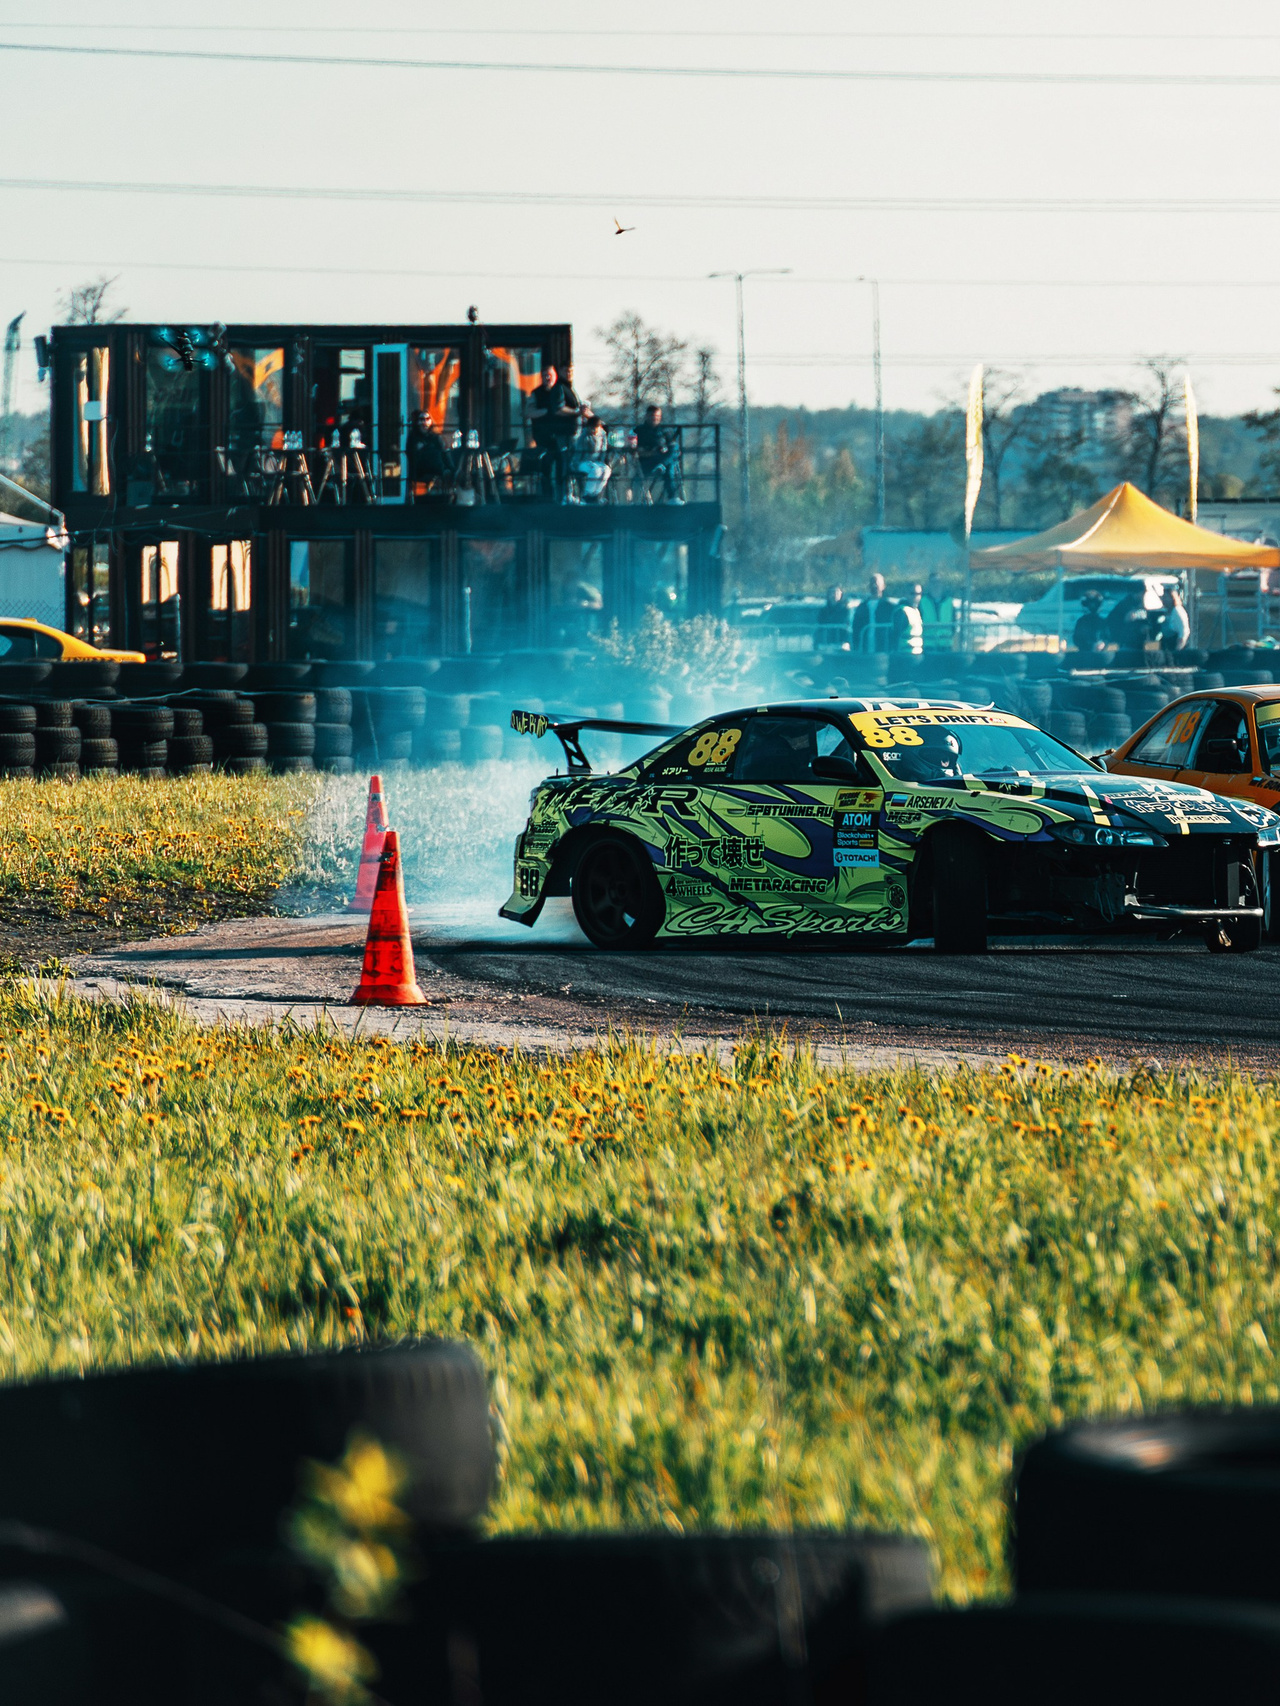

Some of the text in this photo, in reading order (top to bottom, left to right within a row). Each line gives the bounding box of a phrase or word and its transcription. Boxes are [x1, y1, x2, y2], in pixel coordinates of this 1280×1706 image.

[874, 714, 929, 727] LET'S
[1165, 711, 1200, 744] 118
[688, 729, 742, 766] 88
[861, 727, 924, 748] 88
[842, 814, 872, 826] ATOM
[664, 834, 765, 869] 作って壊せ
[843, 854, 876, 862] TOTACHI
[520, 867, 540, 898] 88
[677, 885, 712, 896] WHEELS
[750, 902, 905, 939] Sports
